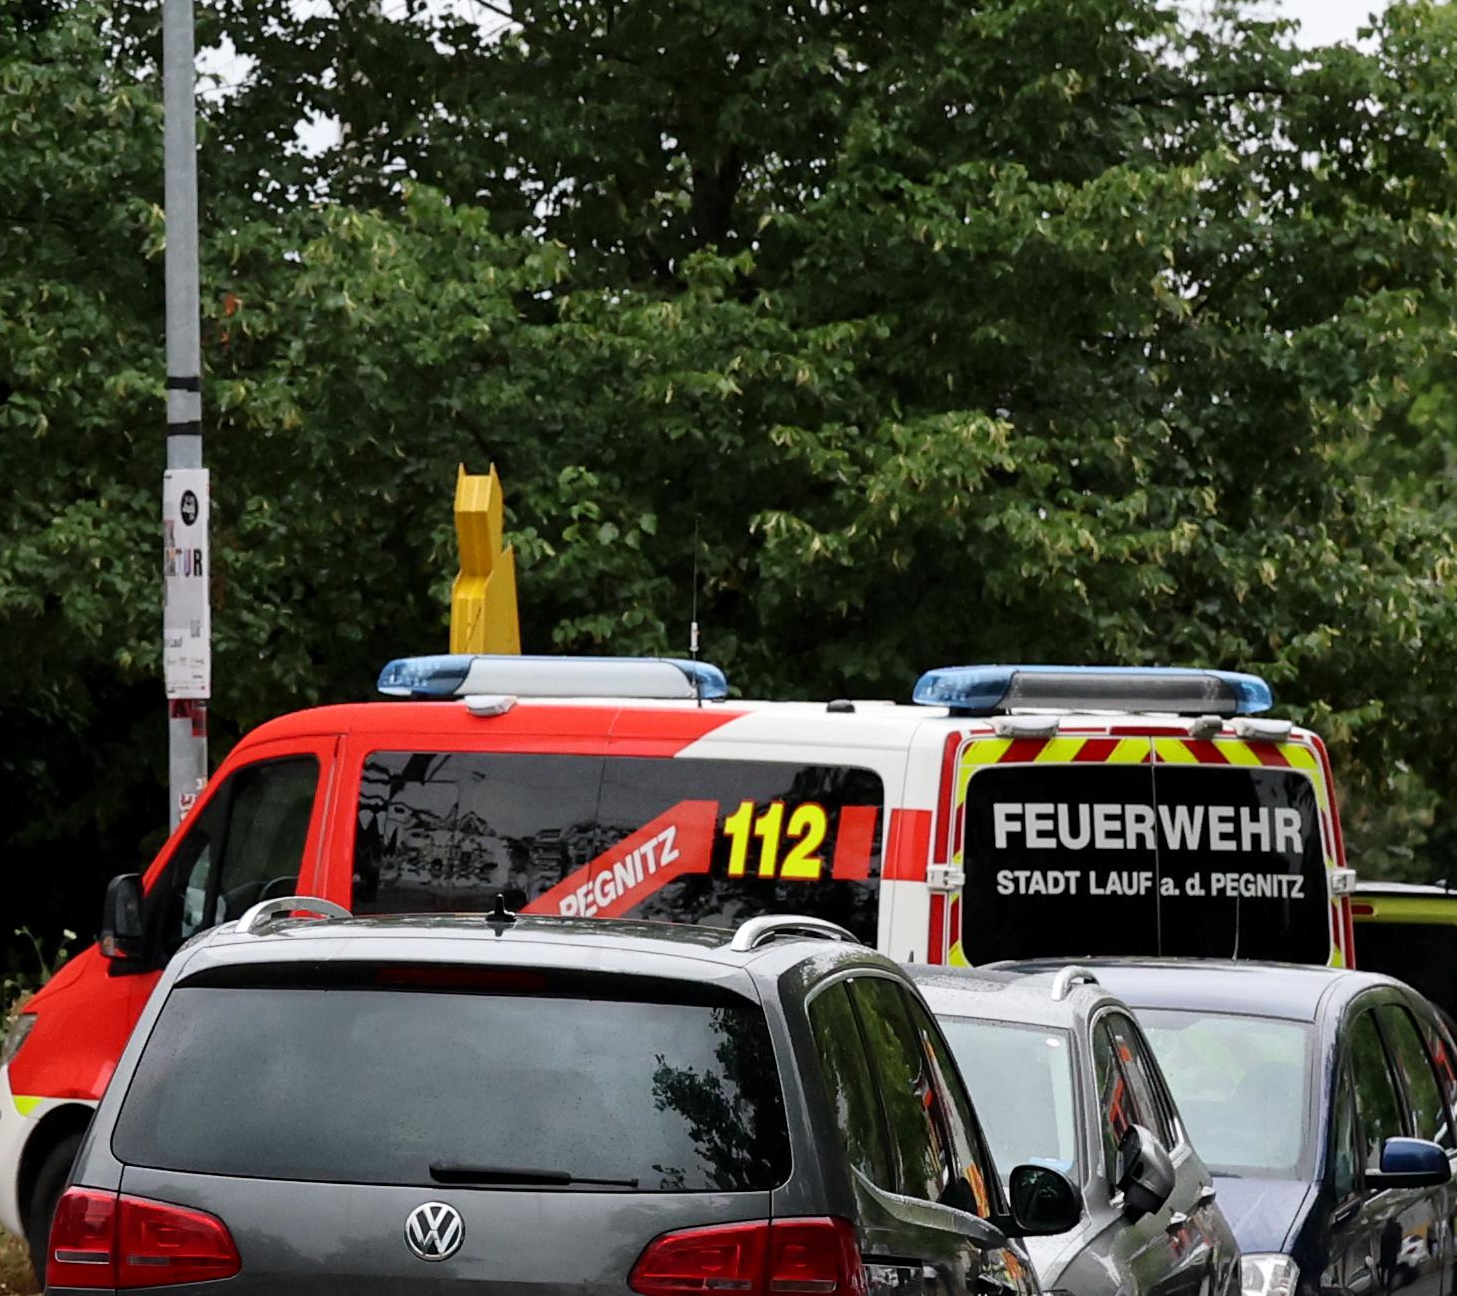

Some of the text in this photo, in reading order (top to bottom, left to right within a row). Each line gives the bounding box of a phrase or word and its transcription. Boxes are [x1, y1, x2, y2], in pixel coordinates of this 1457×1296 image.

[723, 798, 829, 881] 112
[993, 802, 1303, 854] FEUERWEHR
[996, 869, 1305, 900] STADT LAUF a. d. PEGNITZ
